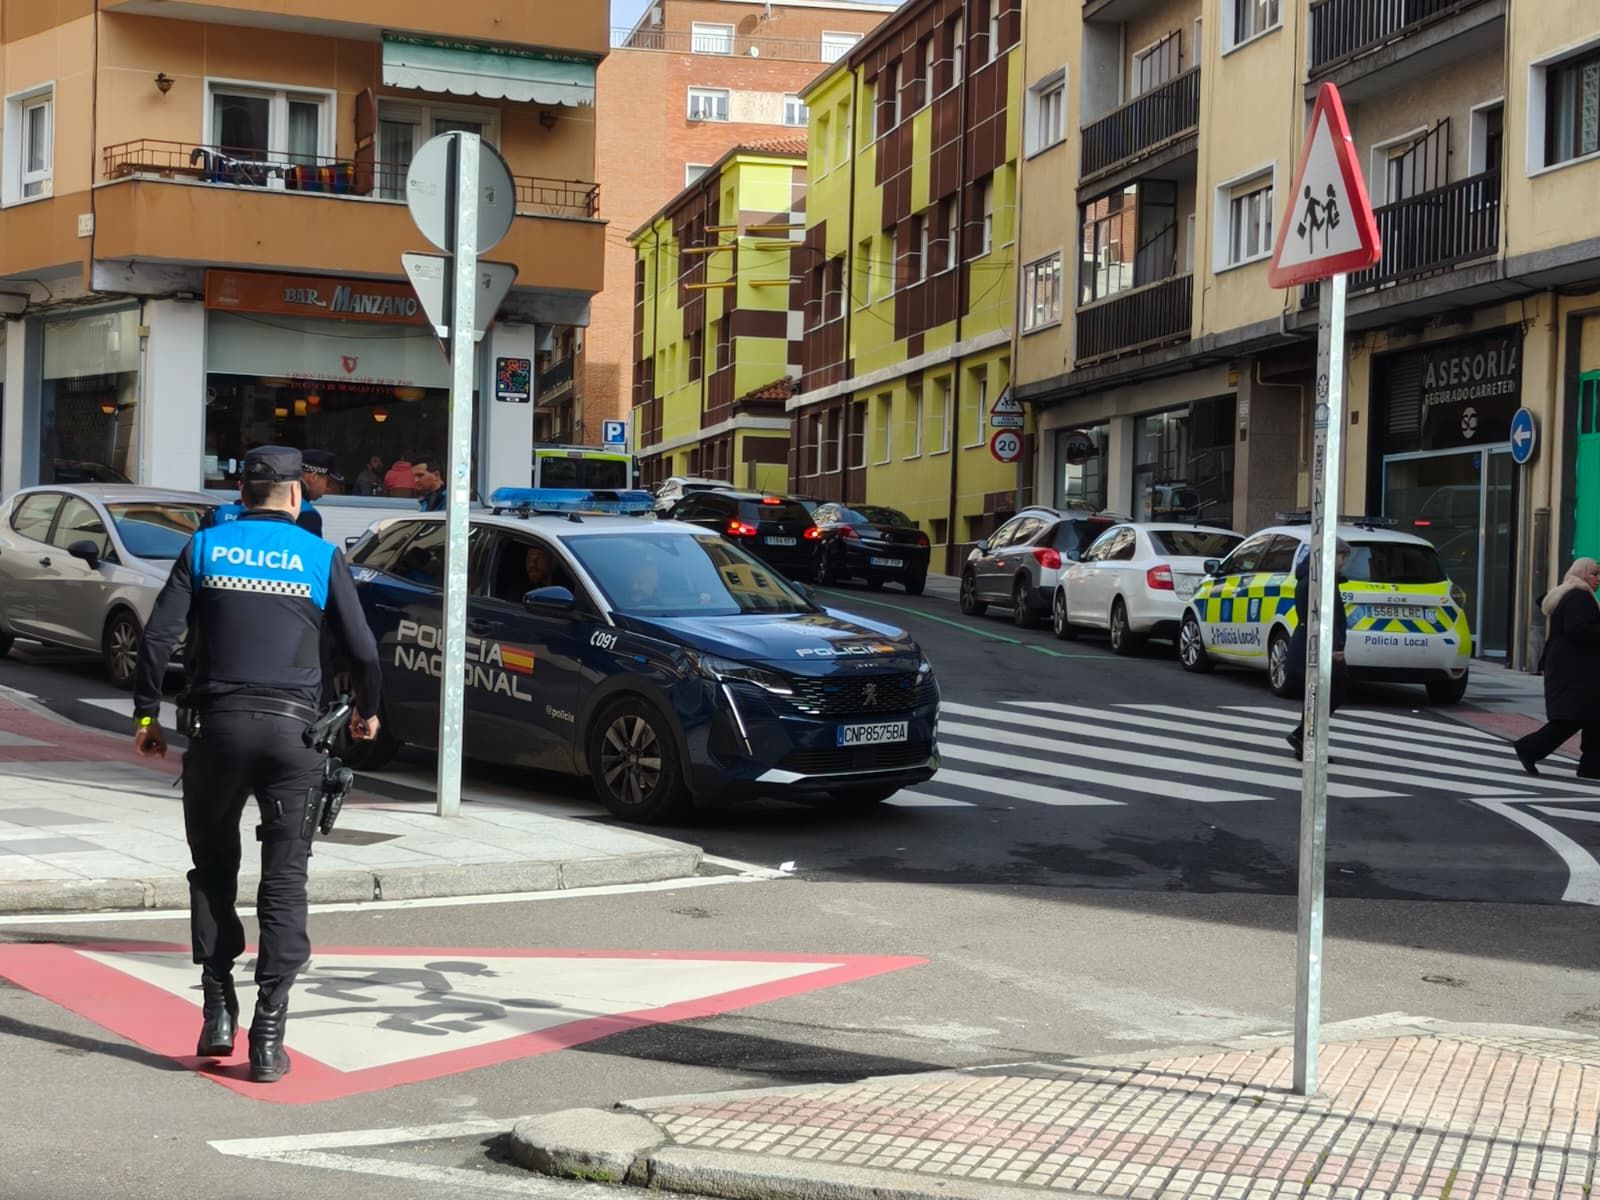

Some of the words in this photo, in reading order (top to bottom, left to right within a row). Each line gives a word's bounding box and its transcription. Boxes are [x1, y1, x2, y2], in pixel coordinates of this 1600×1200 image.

[284, 288, 326, 307] BAR
[330, 285, 417, 317] MANZANO
[1470, 379, 1516, 399] CARRETER
[607, 423, 622, 441] P
[998, 440, 1017, 452] 20
[211, 546, 304, 572] POLICÍA
[1404, 636, 1429, 648] Local
[394, 645, 533, 702] NACONAL
[844, 723, 906, 743] CNP8575BA
